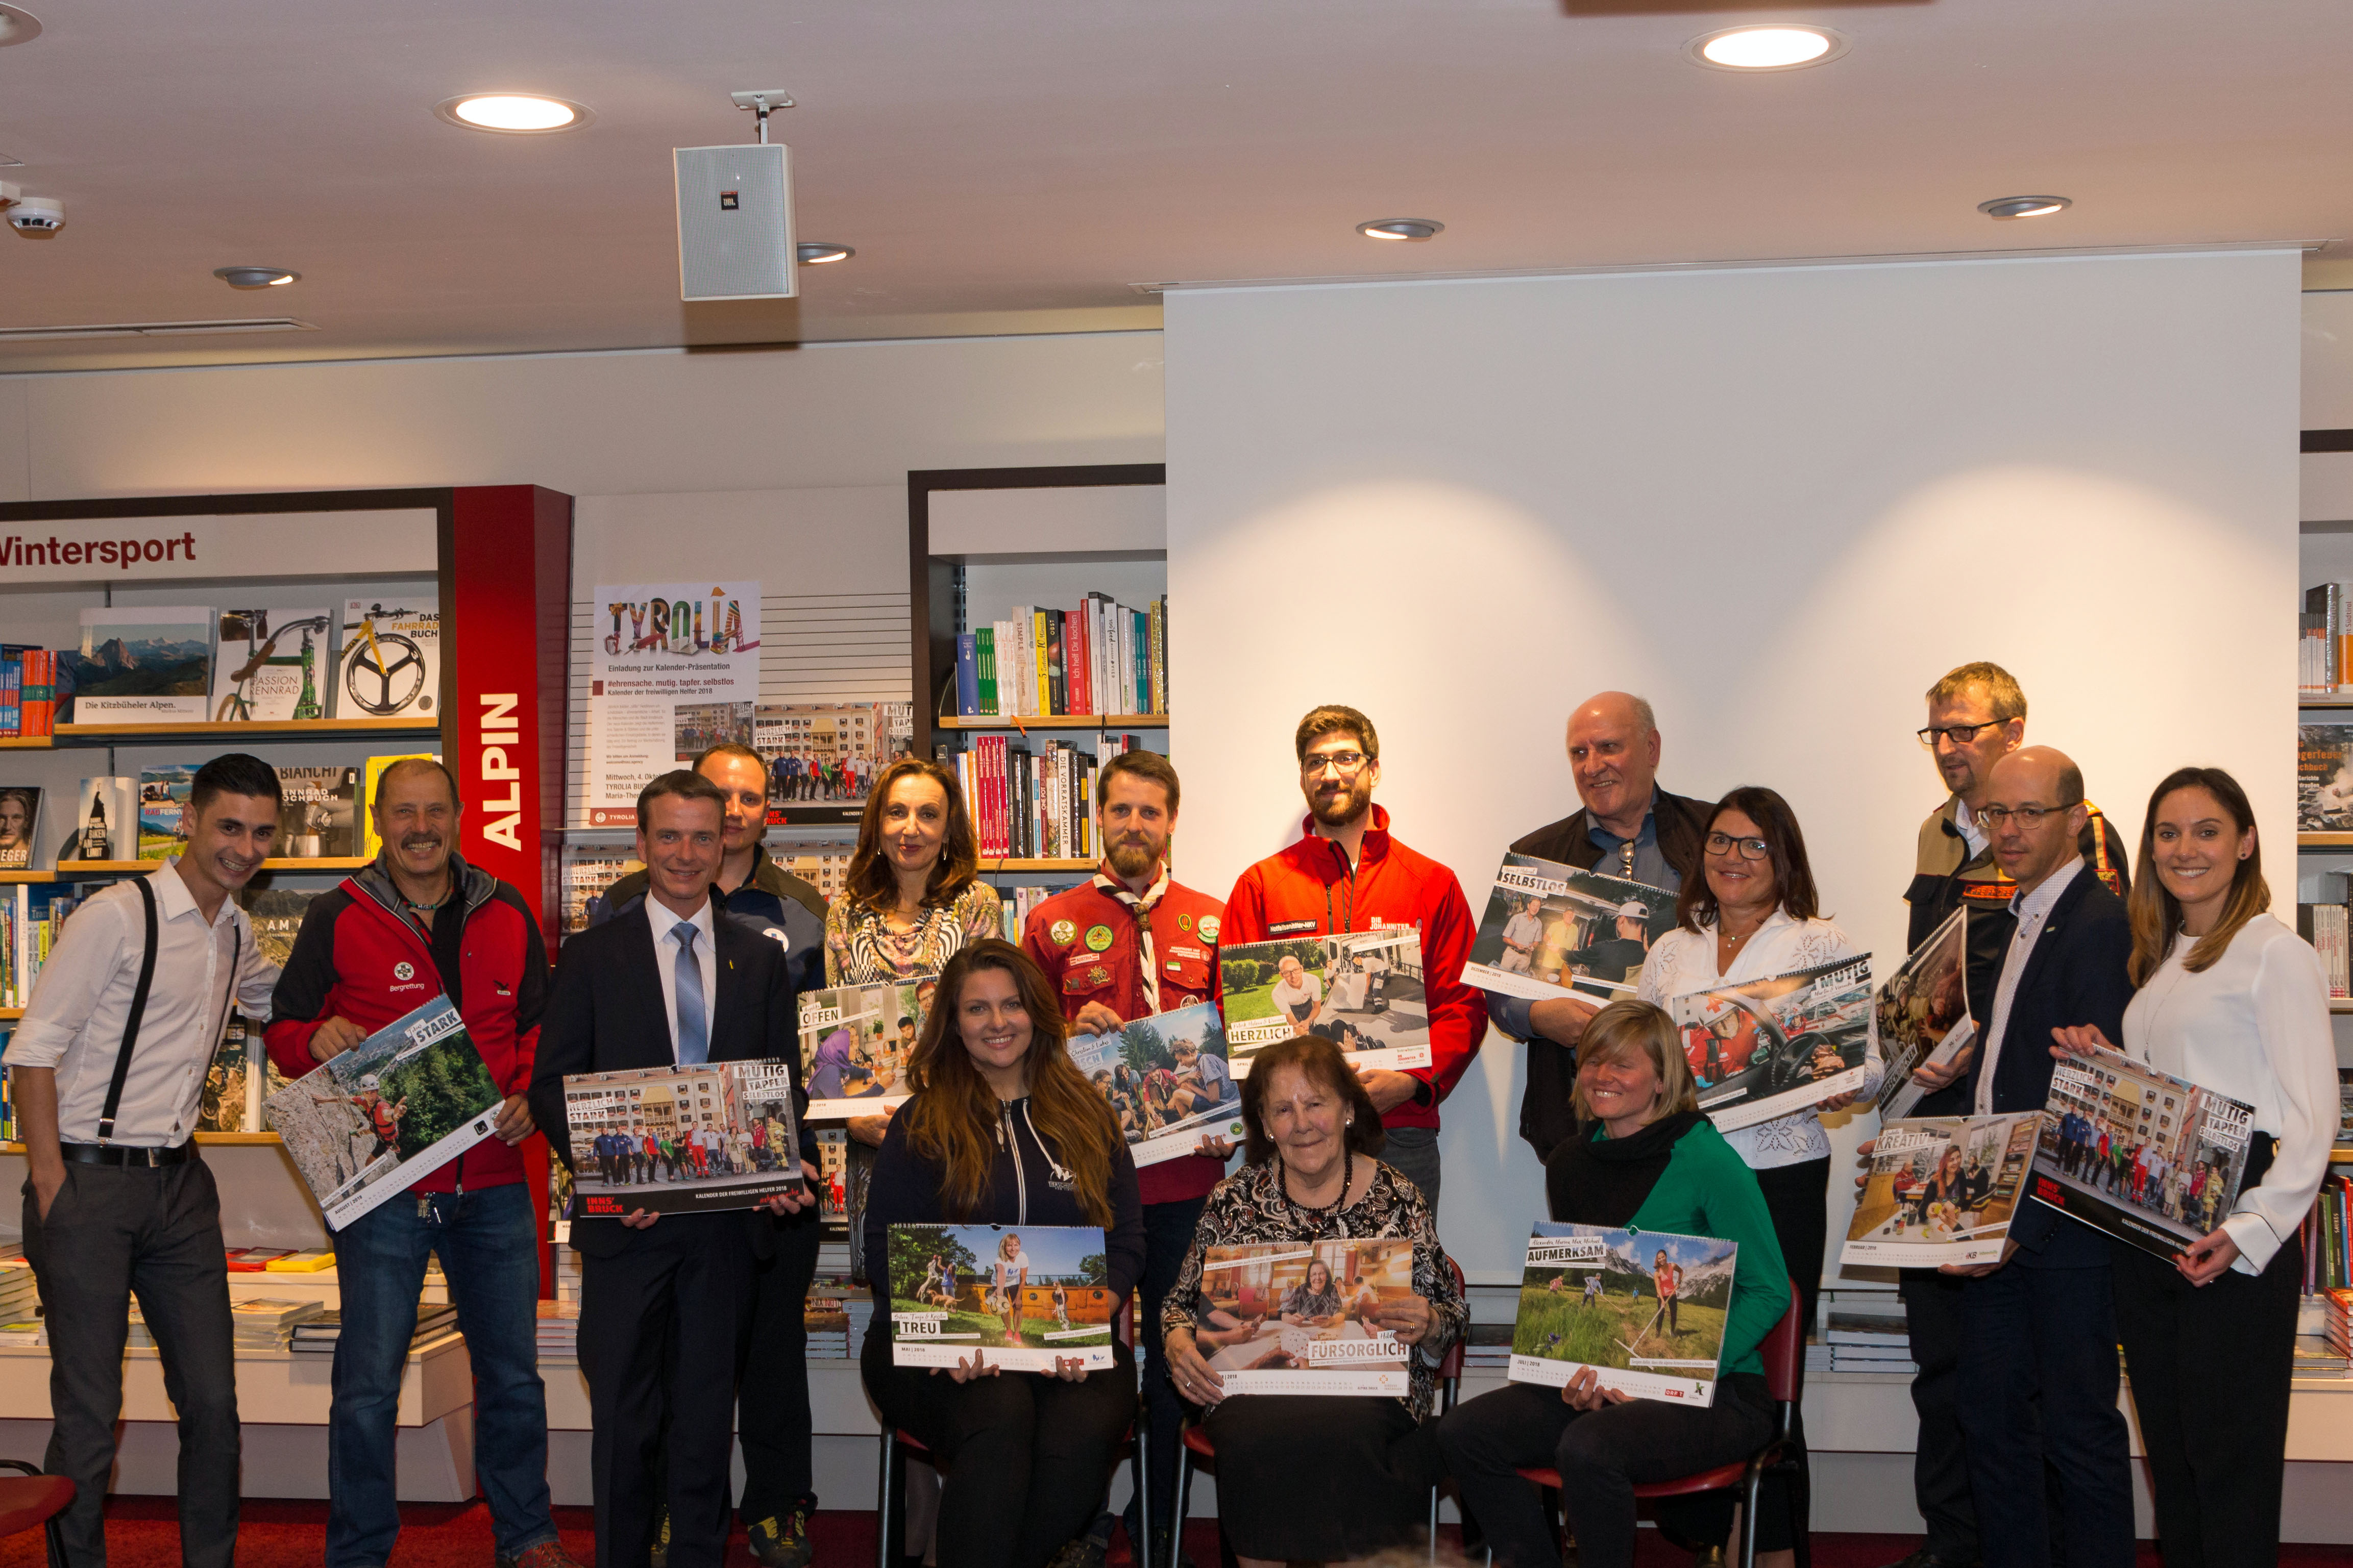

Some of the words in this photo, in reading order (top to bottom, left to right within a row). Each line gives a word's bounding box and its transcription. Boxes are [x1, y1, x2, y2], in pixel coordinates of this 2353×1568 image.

[391, 622, 439, 631] FAHRRAD
[608, 598, 745, 653] TYROLIA
[1037, 639, 1045, 649] 10
[655, 663, 730, 671] Kalender-Präsentation
[253, 676, 298, 685] PASSION
[656, 679, 678, 687] mutig.
[679, 679, 701, 688] tapfer.
[250, 686, 299, 695] RENNRAD
[646, 688, 678, 696] freiwilligen
[149, 701, 176, 710] Alpen.
[756, 725, 790, 736] HERZLICH
[757, 736, 785, 745] STARK
[280, 767, 337, 779] BIANCHI
[480, 693, 522, 852] ALPIN
[1060, 773, 1068, 845] VORRATSKAMMER
[1502, 873, 1564, 893] SELBSTLOS
[267, 919, 289, 931] AM
[1470, 966, 1489, 976] DEZEMBER
[1820, 960, 1868, 988] MUTIG
[390, 983, 425, 992] Bergrettung
[803, 1009, 838, 1024] OFFEN
[416, 1011, 457, 1042] STARK
[1231, 1027, 1290, 1041] HERZLICH
[738, 1065, 785, 1078] MUTIG
[2056, 1067, 2093, 1083] HERZLICH
[749, 1077, 788, 1091] TAPFER
[2053, 1077, 2082, 1097] STARK
[569, 1098, 612, 1111] HERZLICH
[2204, 1096, 2248, 1124] MUTIG
[569, 1111, 605, 1121] STARK
[2210, 1117, 2246, 1137] TAPFER
[1877, 1133, 1928, 1150] KREATIV
[2200, 1127, 2238, 1150] SELBSTLOS
[334, 1203, 351, 1215] AUGUST
[352, 1194, 363, 1204] 2018
[587, 1205, 623, 1213] BRUCK
[1528, 1244, 1603, 1261] AUFMERKSAM
[902, 1322, 937, 1333] TREU
[1311, 1341, 1406, 1358] FÜRSORGLICH
